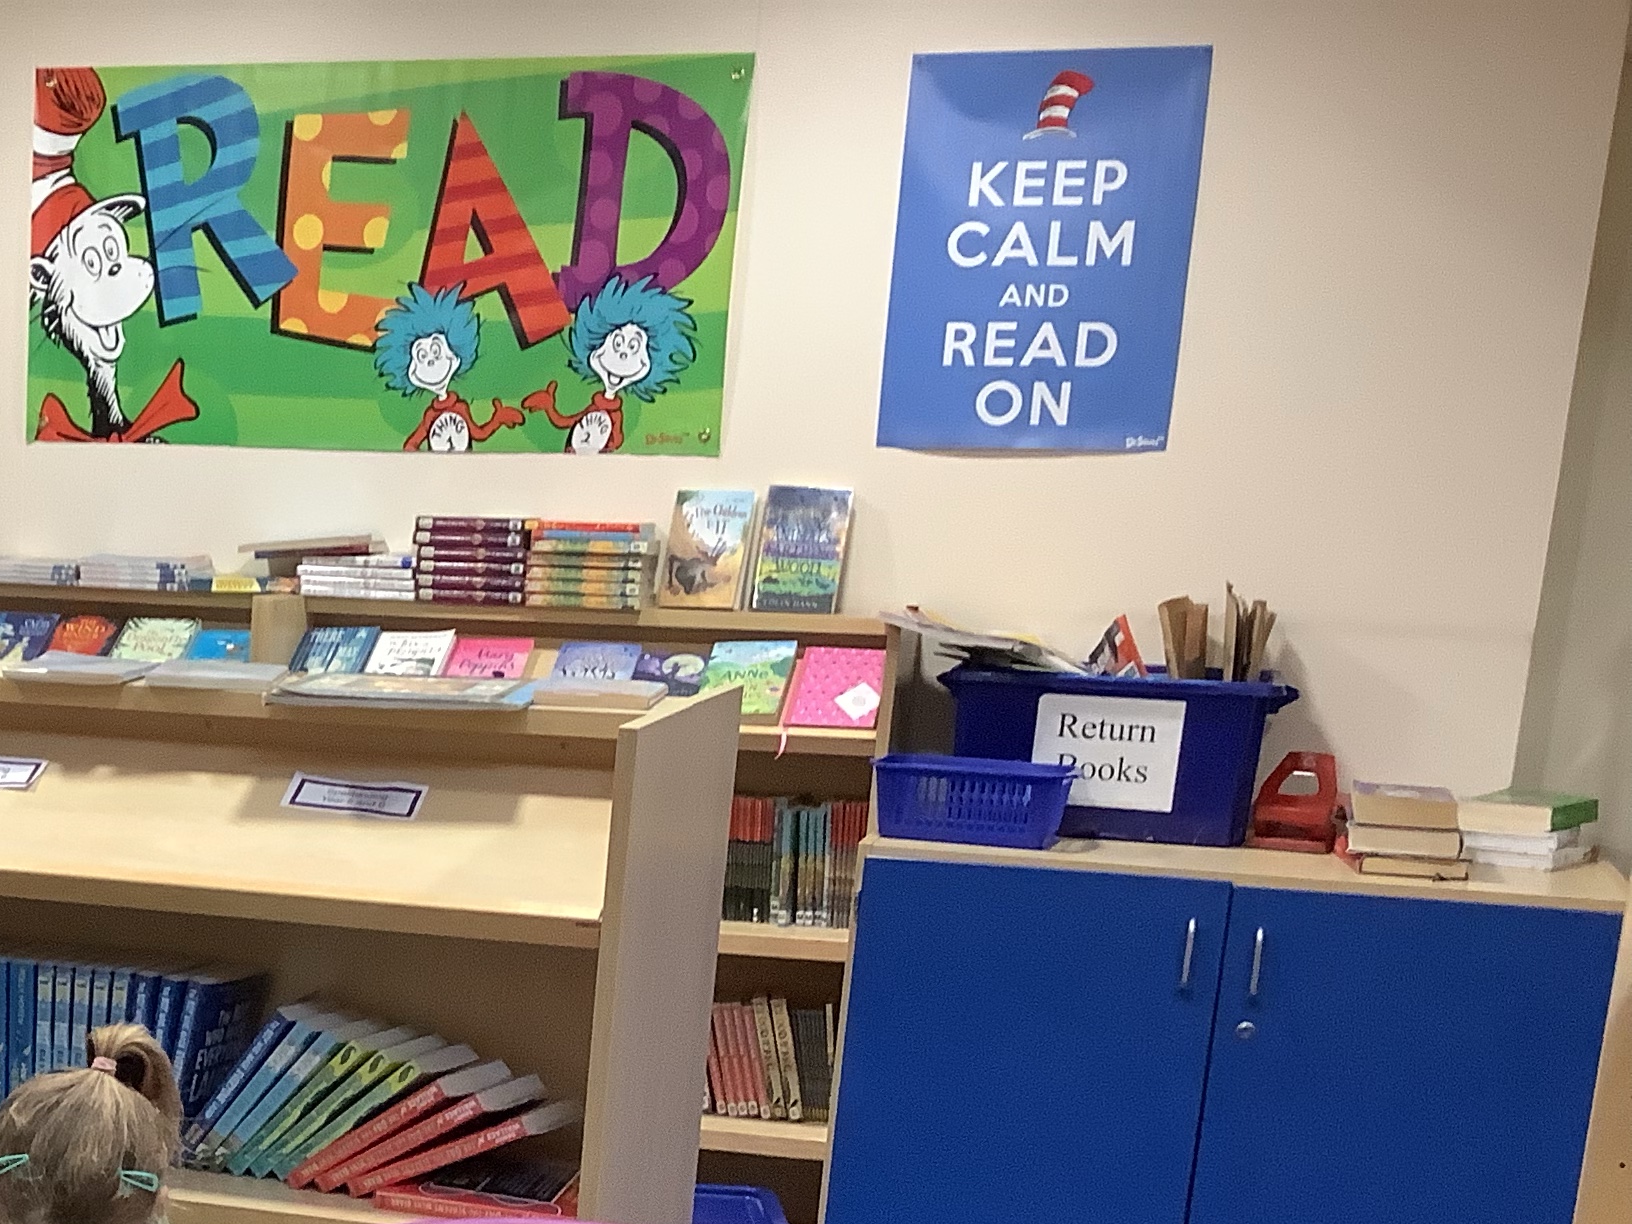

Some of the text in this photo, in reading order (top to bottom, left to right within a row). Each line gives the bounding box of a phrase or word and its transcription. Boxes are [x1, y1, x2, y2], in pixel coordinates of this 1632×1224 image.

[968, 159, 1128, 207] KEEP
[112, 72, 730, 350] READ
[947, 220, 1136, 267] CALM
[999, 284, 1069, 307] AND
[942, 321, 1117, 367] READ
[975, 380, 1071, 426] ON
[431, 414, 466, 441] THING
[446, 436, 455, 450] 1
[1056, 712, 1156, 743] Return
